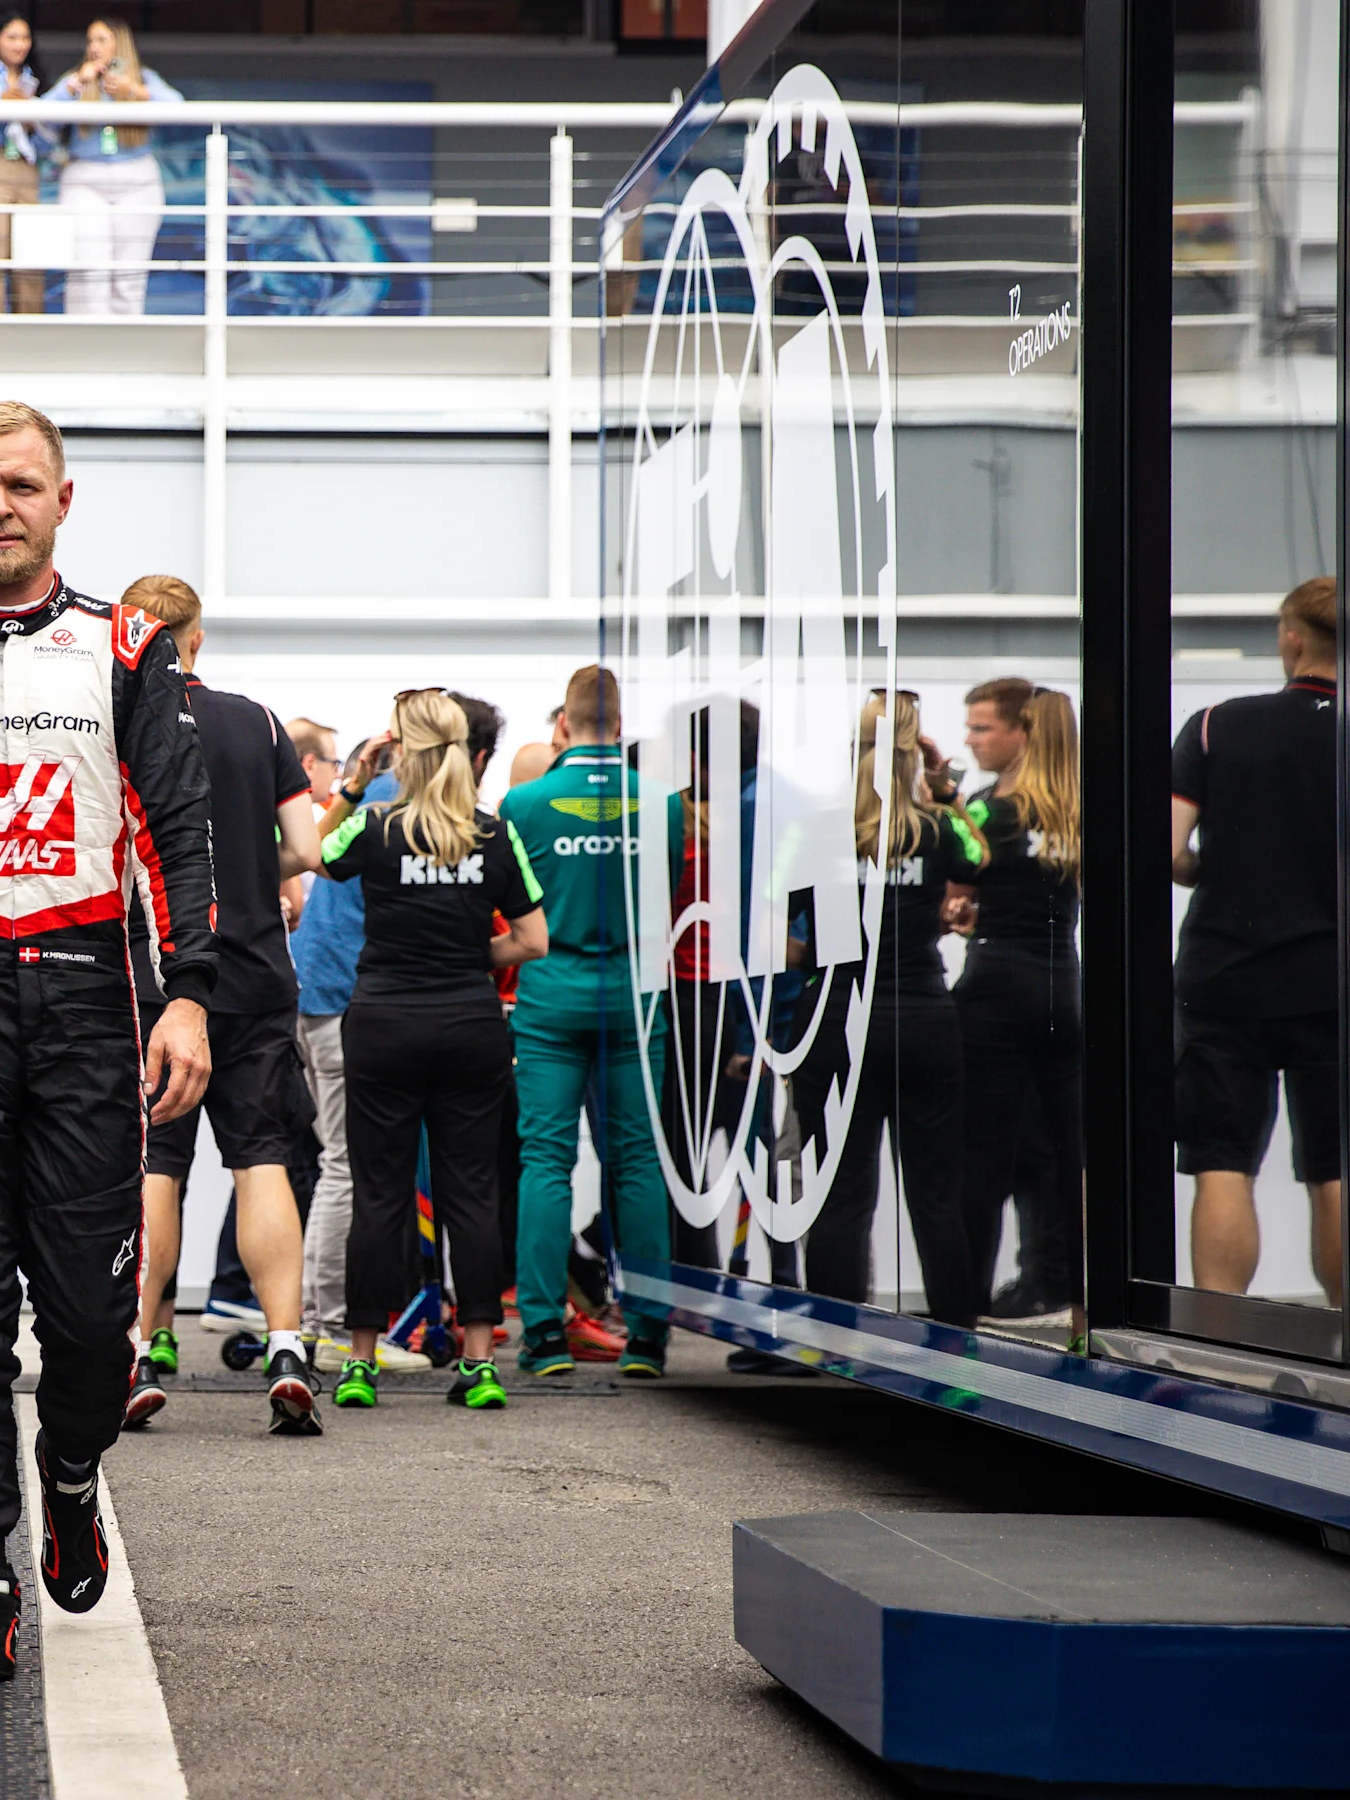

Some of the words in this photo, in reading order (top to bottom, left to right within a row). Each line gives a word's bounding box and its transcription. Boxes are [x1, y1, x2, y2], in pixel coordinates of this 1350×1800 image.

[1009, 284, 1021, 323] T2
[1009, 301, 1071, 377] OPERATIONS
[33, 646, 94, 657] MoneyGram
[42, 951, 96, 963] K.MAGNUSSEN
